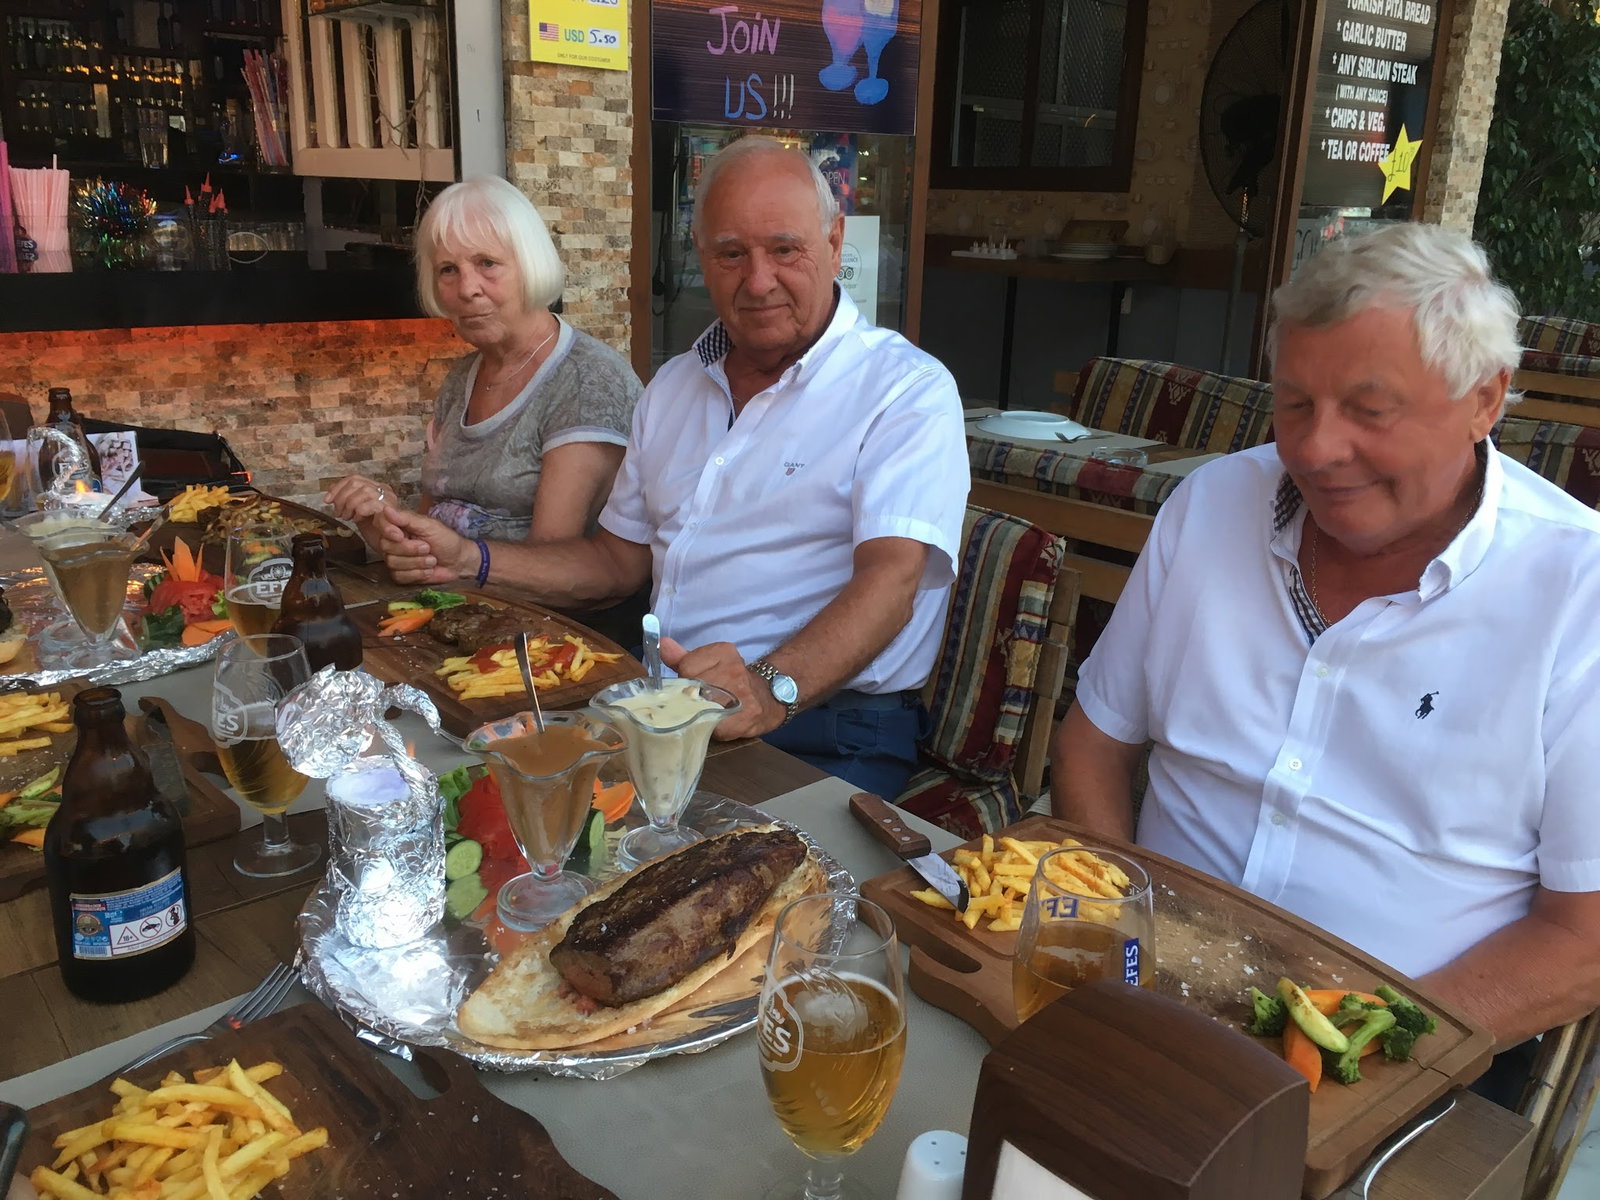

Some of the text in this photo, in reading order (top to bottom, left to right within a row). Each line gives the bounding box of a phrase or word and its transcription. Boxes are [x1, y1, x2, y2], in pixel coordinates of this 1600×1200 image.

[1385, 0, 1403, 19] PITA
[1404, 1, 1431, 25] BREAD
[564, 28, 617, 44] USD 5.50
[1342, 20, 1408, 52] GARLIC BUTTER
[1337, 53, 1419, 85] ANY SIRLION STEAK
[1354, 86, 1369, 101] ANY
[1330, 107, 1386, 133] CHIPS & VEG.
[1327, 138, 1390, 163] TEA OR COFFEE
[783, 461, 806, 469] GANT
